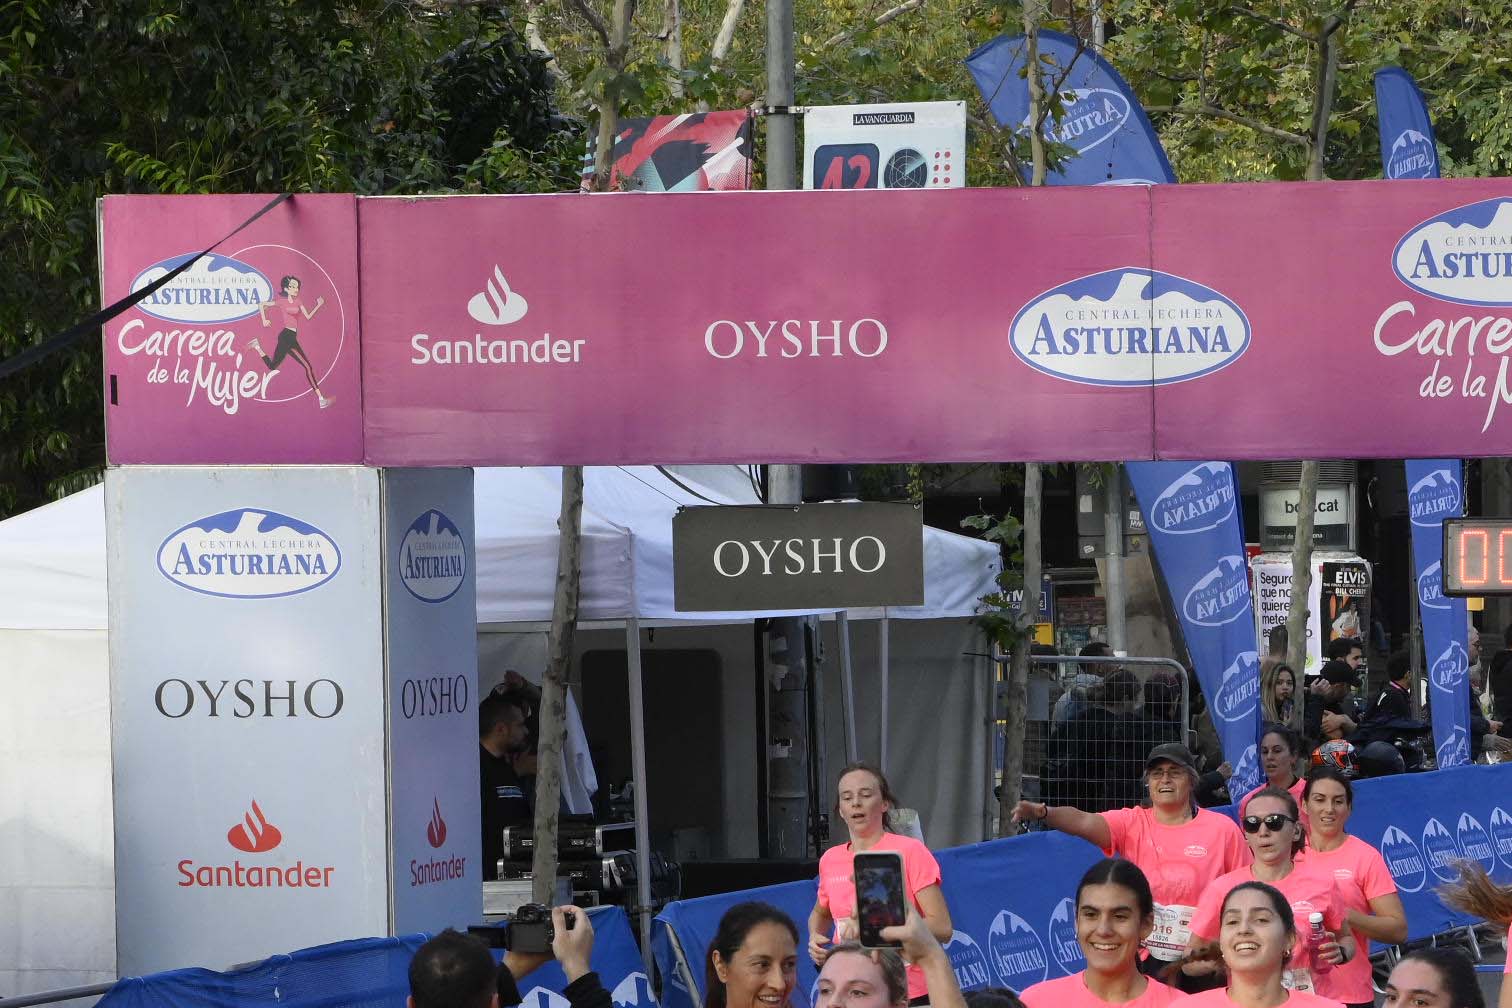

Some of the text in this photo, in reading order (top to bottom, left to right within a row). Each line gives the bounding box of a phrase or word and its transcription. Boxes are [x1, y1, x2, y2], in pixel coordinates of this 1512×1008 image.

[141, 279, 261, 306] ASTURIANA
[1065, 308, 1224, 321] CENTRAL LECHERA
[118, 320, 236, 357] Carrera
[411, 333, 586, 365] Santander
[704, 318, 889, 359] OYSHO
[1029, 312, 1233, 356] ASTURIANA
[147, 353, 281, 414] de la Mujer
[1420, 360, 1454, 398] de
[1462, 358, 1487, 398] la
[171, 542, 329, 576] ASTURIANA
[199, 540, 322, 549] CENTRAL LECHERA
[713, 535, 886, 577] OYSHO
[404, 544, 463, 580] ASTURIANA
[1335, 571, 1366, 584] ELVIS
[1260, 588, 1277, 600] que
[1335, 587, 1347, 595] BILL
[154, 678, 344, 719] OYSHO
[401, 674, 468, 719] OYSHO
[177, 859, 335, 888] Santander
[411, 854, 466, 887] Santander
